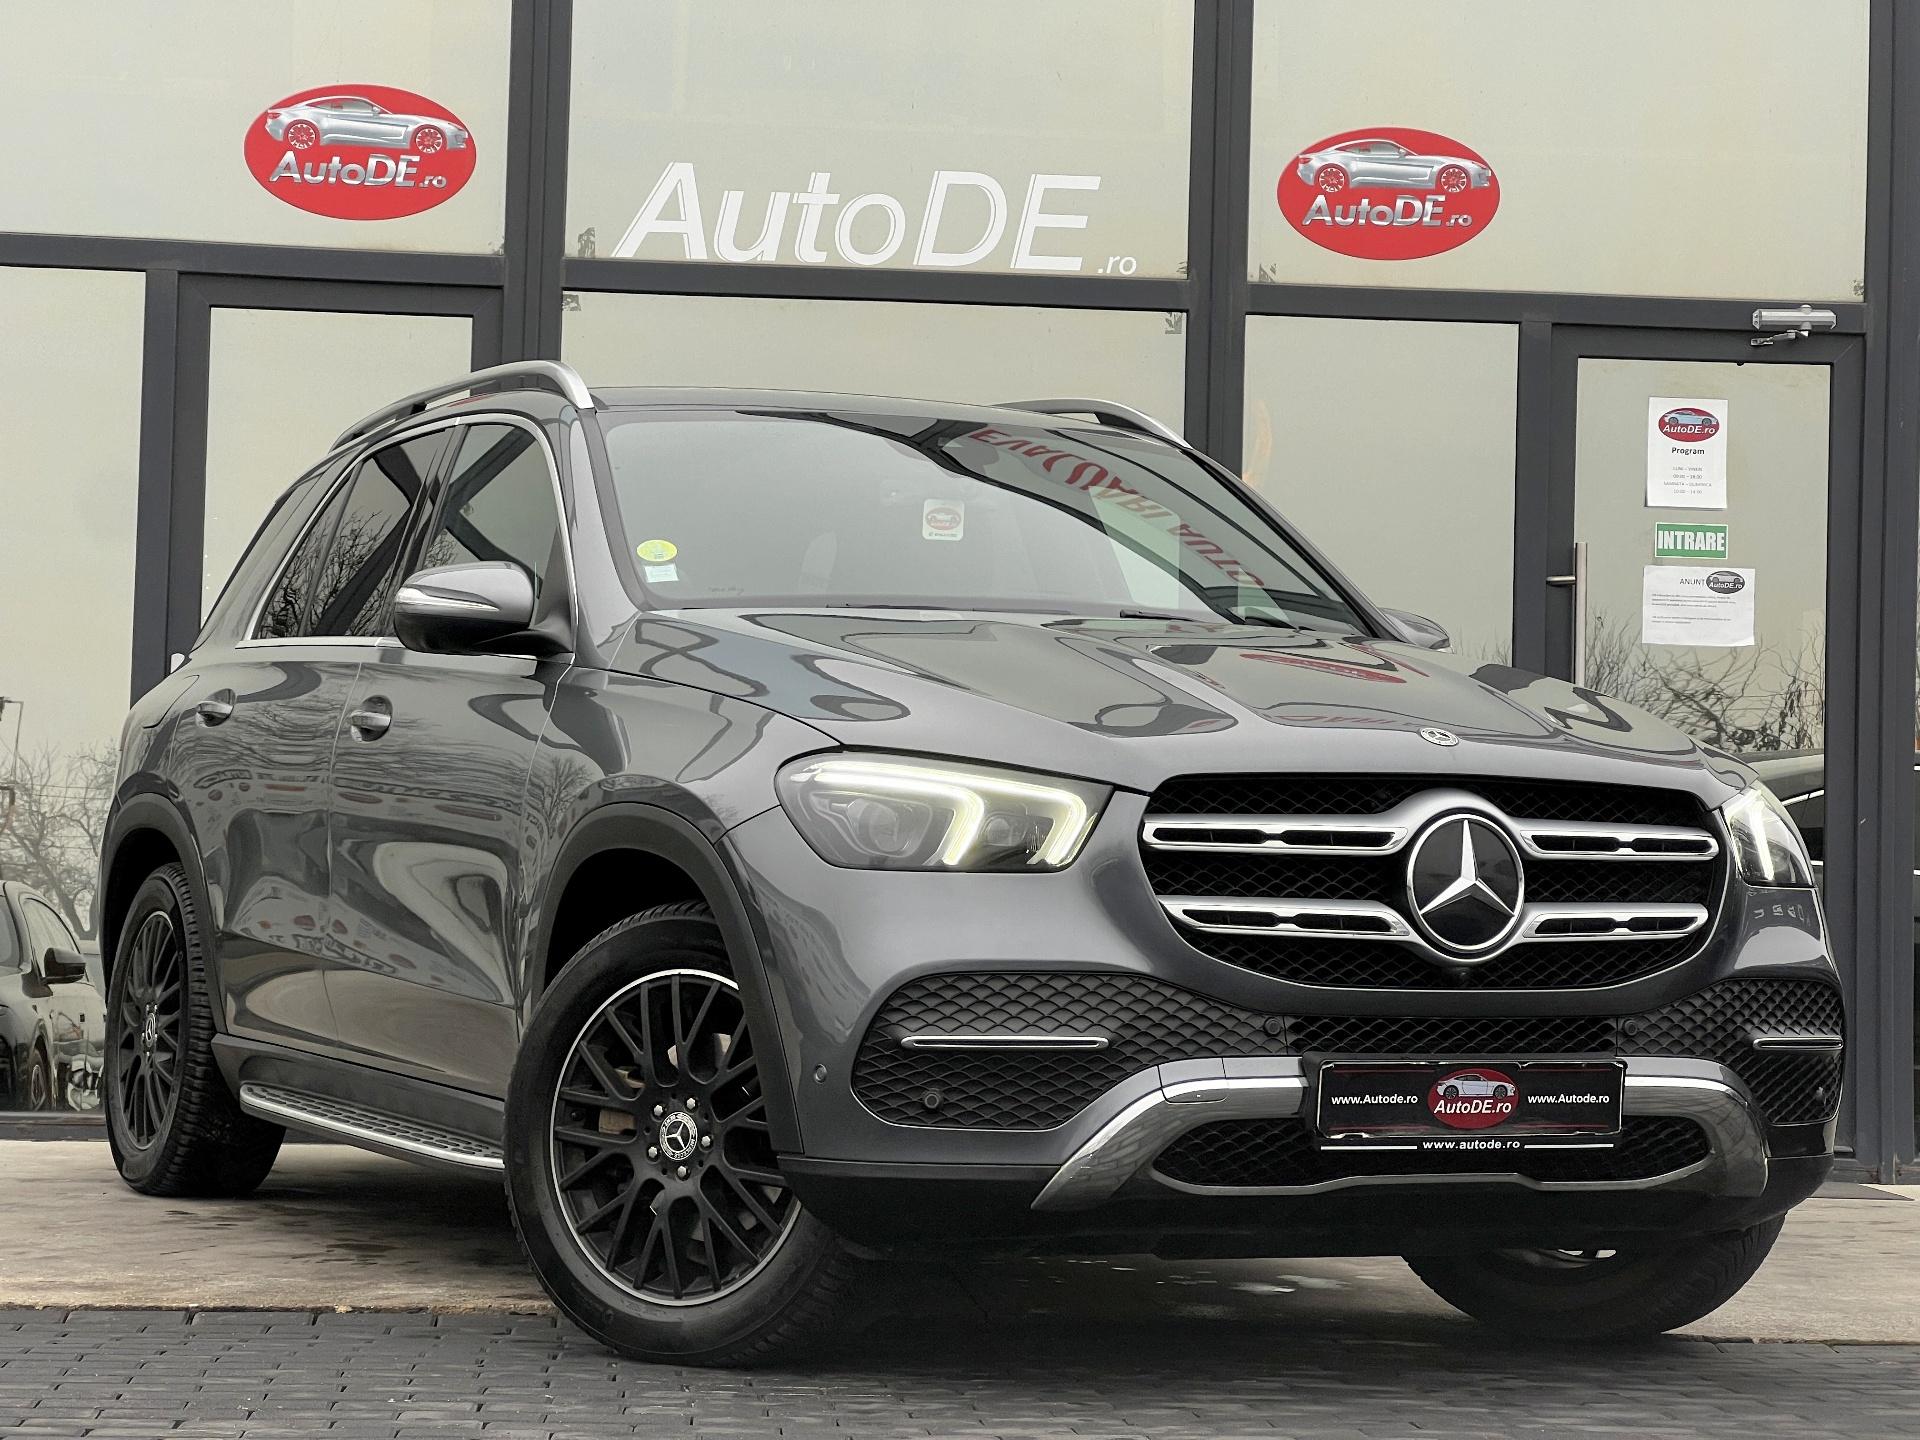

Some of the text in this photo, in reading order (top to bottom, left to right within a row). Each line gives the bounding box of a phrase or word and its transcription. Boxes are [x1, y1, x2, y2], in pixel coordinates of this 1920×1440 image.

[1662, 425, 1716, 435] AutoDE.ro
[1671, 447, 1705, 456] Program
[1657, 531, 1725, 551] INTRARE
[1708, 581, 1743, 590] AutoDE.ro
[1331, 1093, 1418, 1105] www.Autode.ro
[1527, 1093, 1610, 1104] www.Autode.ro
[1433, 1099, 1512, 1114] AutoDE.ro
[1422, 1138, 1521, 1150] www.autode.ro
